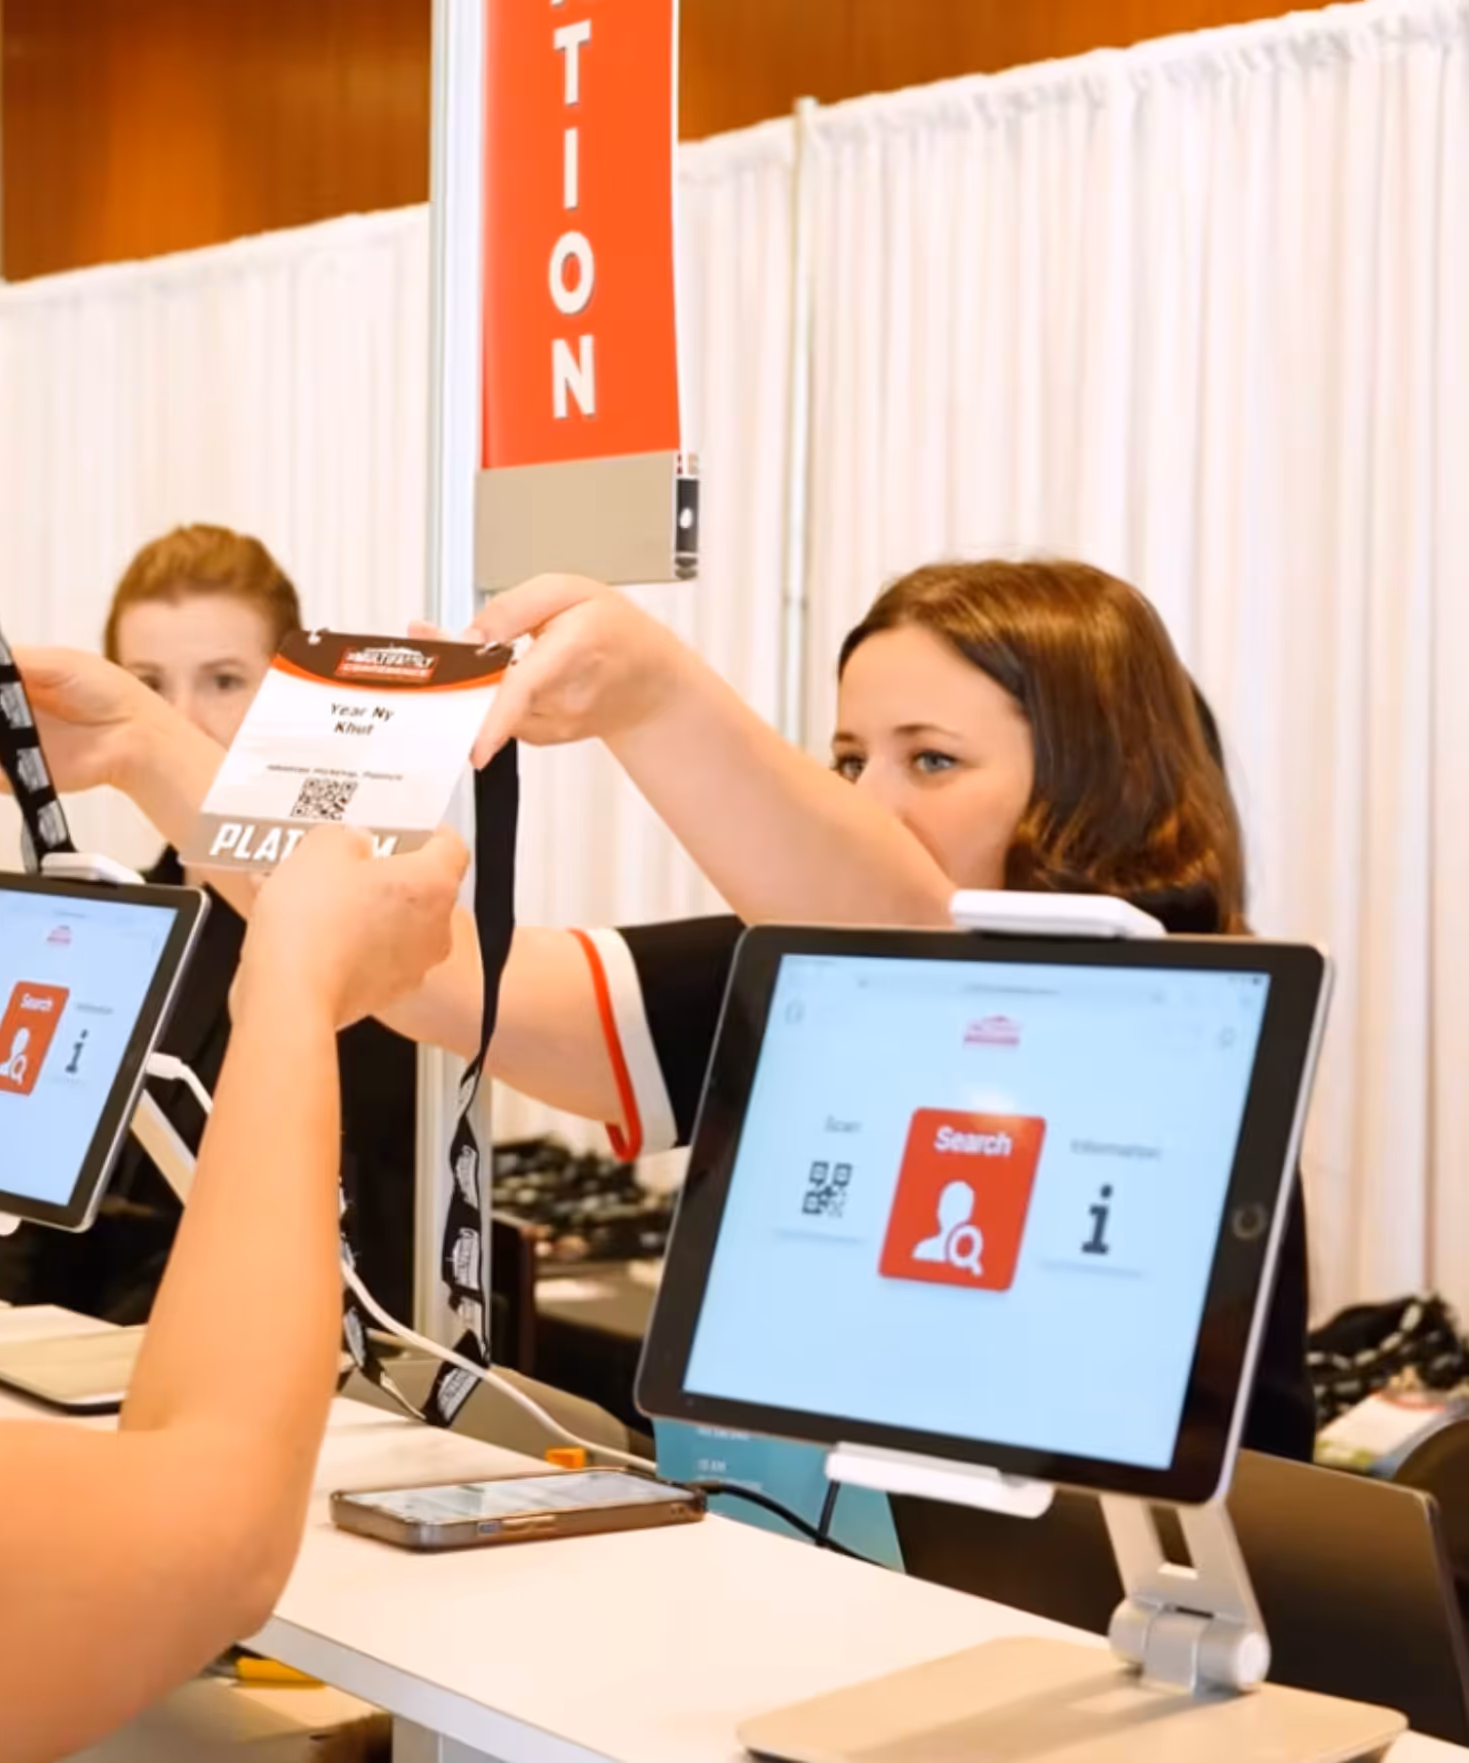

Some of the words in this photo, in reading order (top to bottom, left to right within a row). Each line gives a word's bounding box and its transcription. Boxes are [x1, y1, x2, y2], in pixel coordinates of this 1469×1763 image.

[548, 0, 596, 420] TION
[209, 822, 398, 861] PLATM
[933, 1125, 1012, 1156] Search
